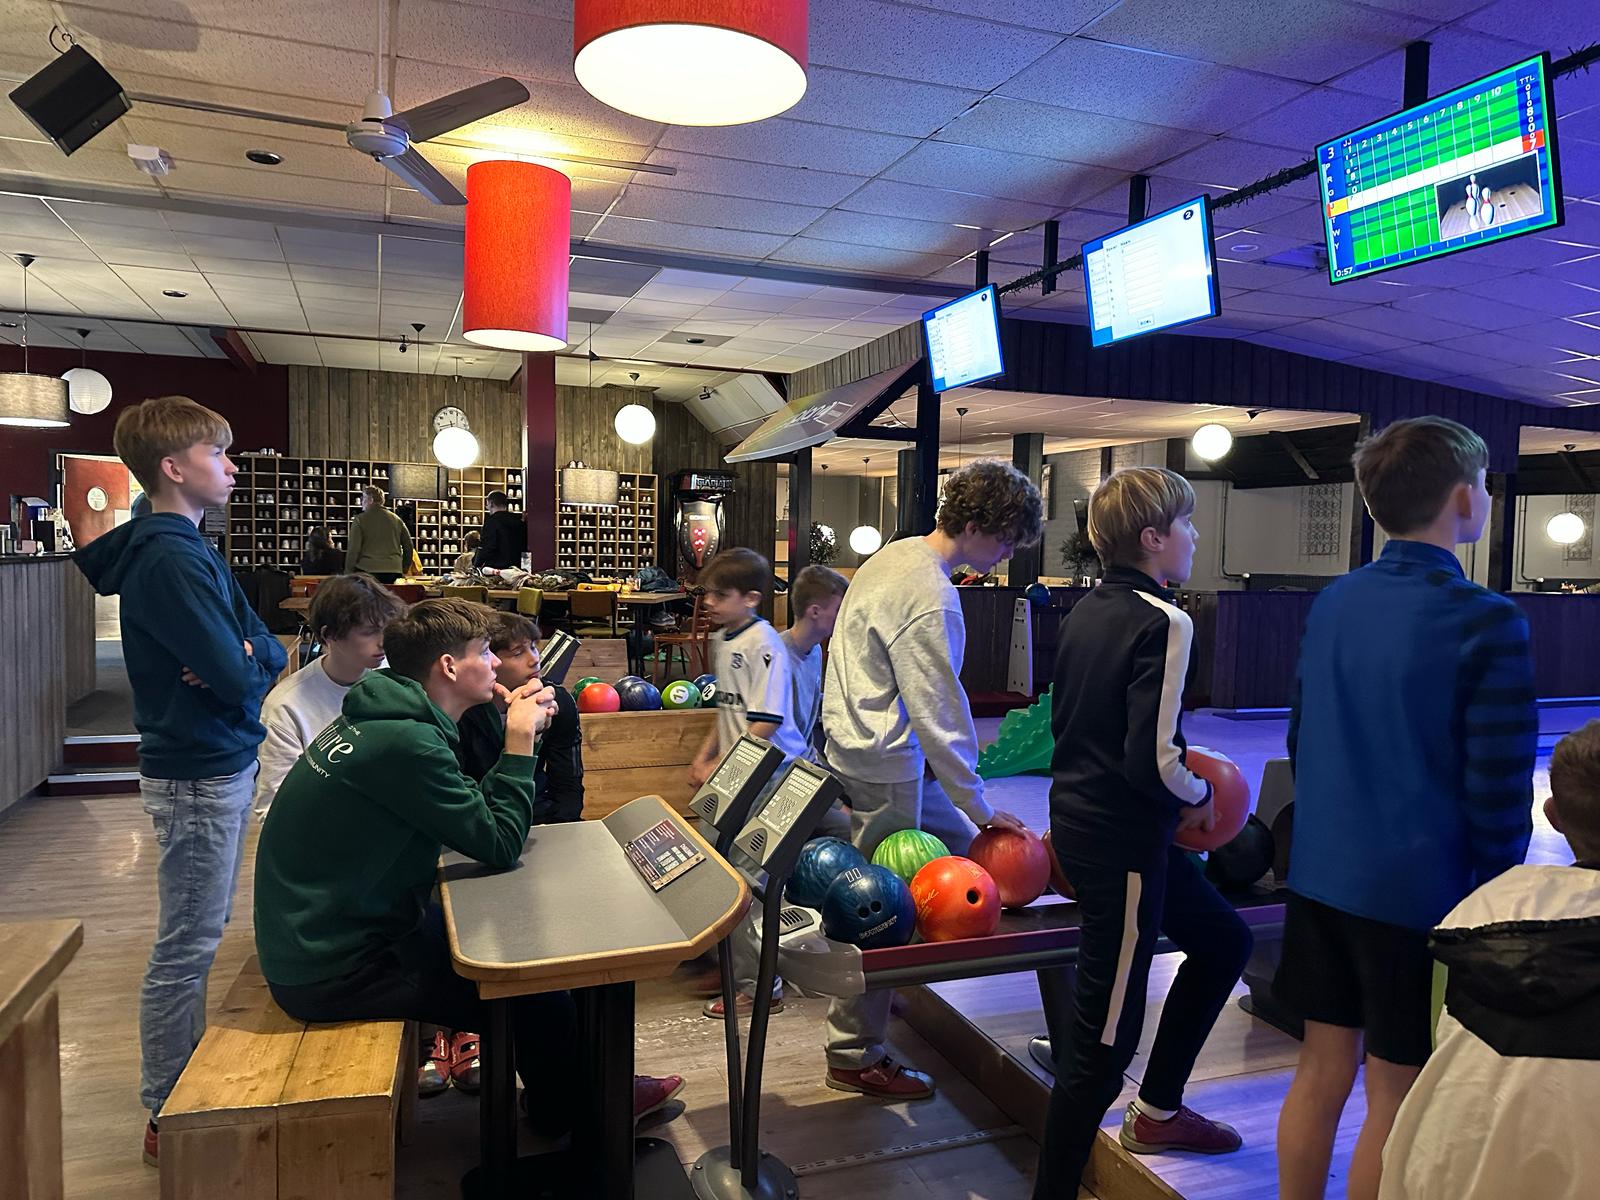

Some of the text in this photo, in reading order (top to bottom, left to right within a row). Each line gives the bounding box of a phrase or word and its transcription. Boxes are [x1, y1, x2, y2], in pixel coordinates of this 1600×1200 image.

[1520, 75, 1535, 85] TTL
[1362, 139, 1367, 148] 2
[1376, 133, 1382, 142] 3
[1391, 128, 1397, 136] 4
[1407, 122, 1413, 130] 5
[1423, 115, 1429, 123] 6
[1440, 108, 1446, 117] 7
[1456, 101, 1463, 110] 8
[1474, 94, 1481, 103] 9
[1491, 86, 1501, 97] 10
[1526, 106, 1534, 117] 8
[1528, 122, 1535, 133] 0
[1529, 138, 1537, 150] 7
[1327, 147, 1335, 159] 3
[1335, 266, 1353, 278] 0:57
